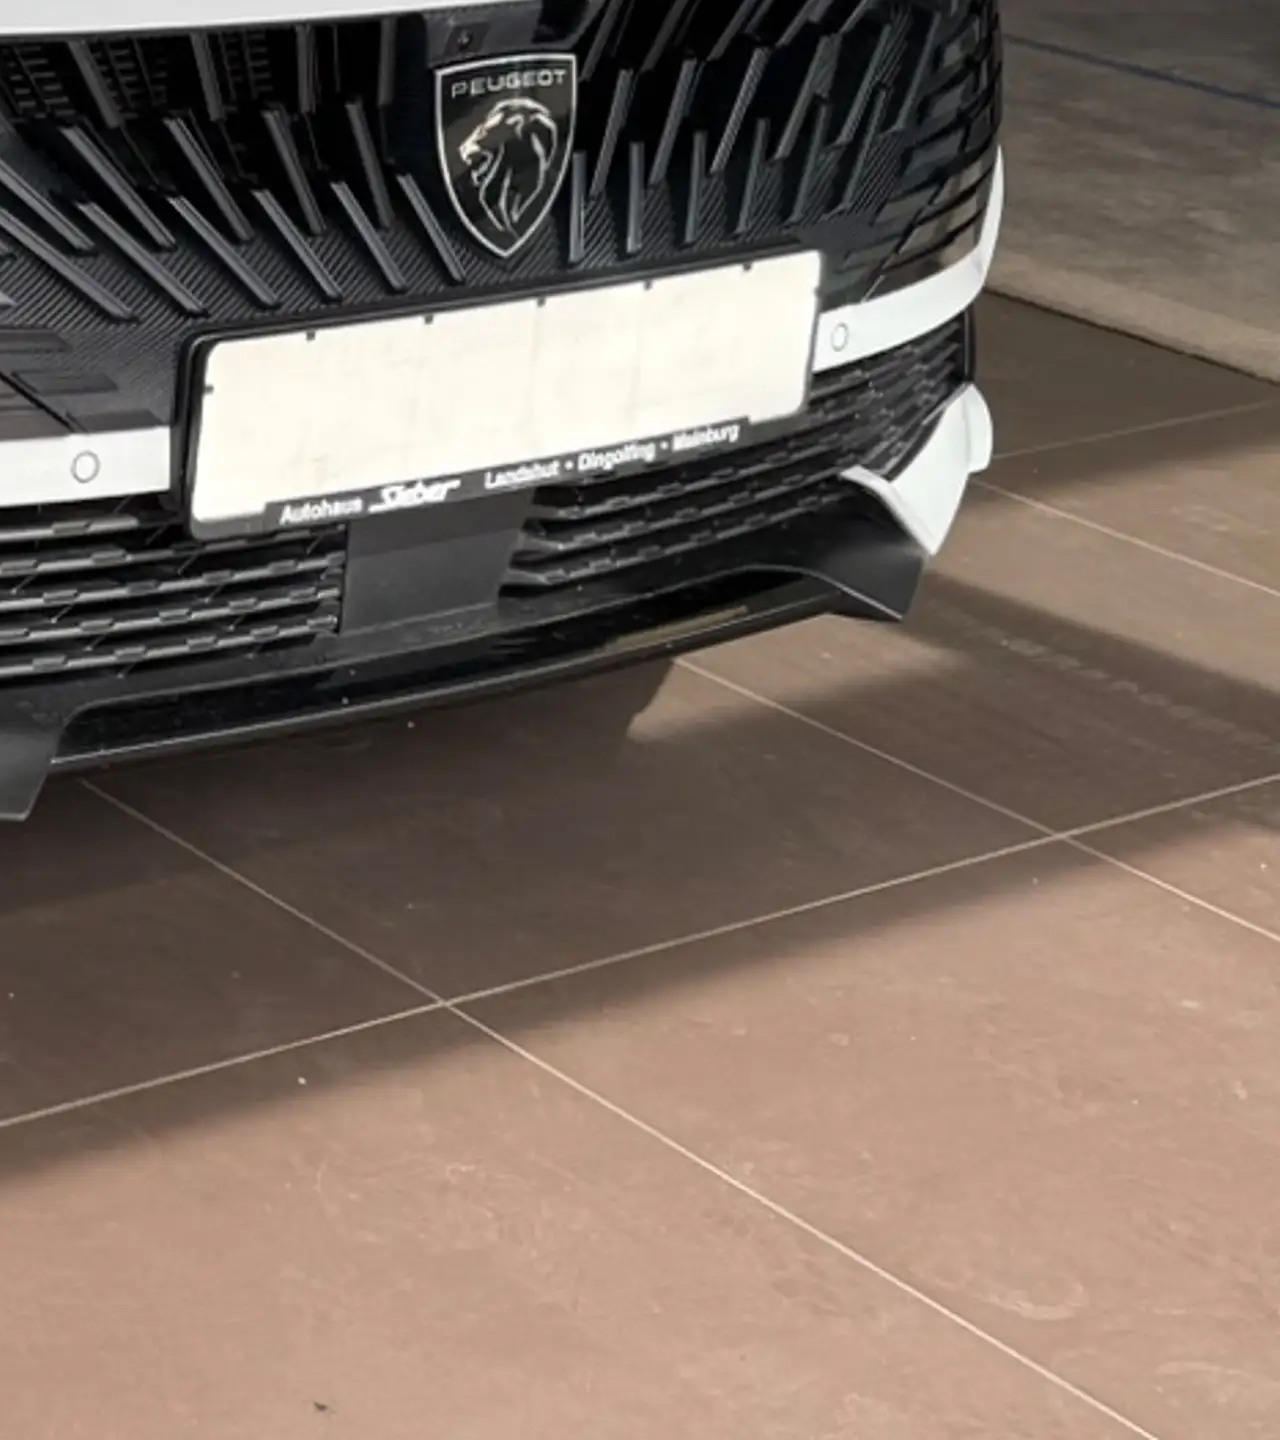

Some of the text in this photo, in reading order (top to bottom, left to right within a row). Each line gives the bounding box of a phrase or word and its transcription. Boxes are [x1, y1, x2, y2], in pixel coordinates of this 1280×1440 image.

[451, 68, 567, 99] PEUGEOT
[278, 495, 363, 526] Autohaus
[483, 459, 560, 490] Landshut
[577, 441, 657, 472] Dingolfing
